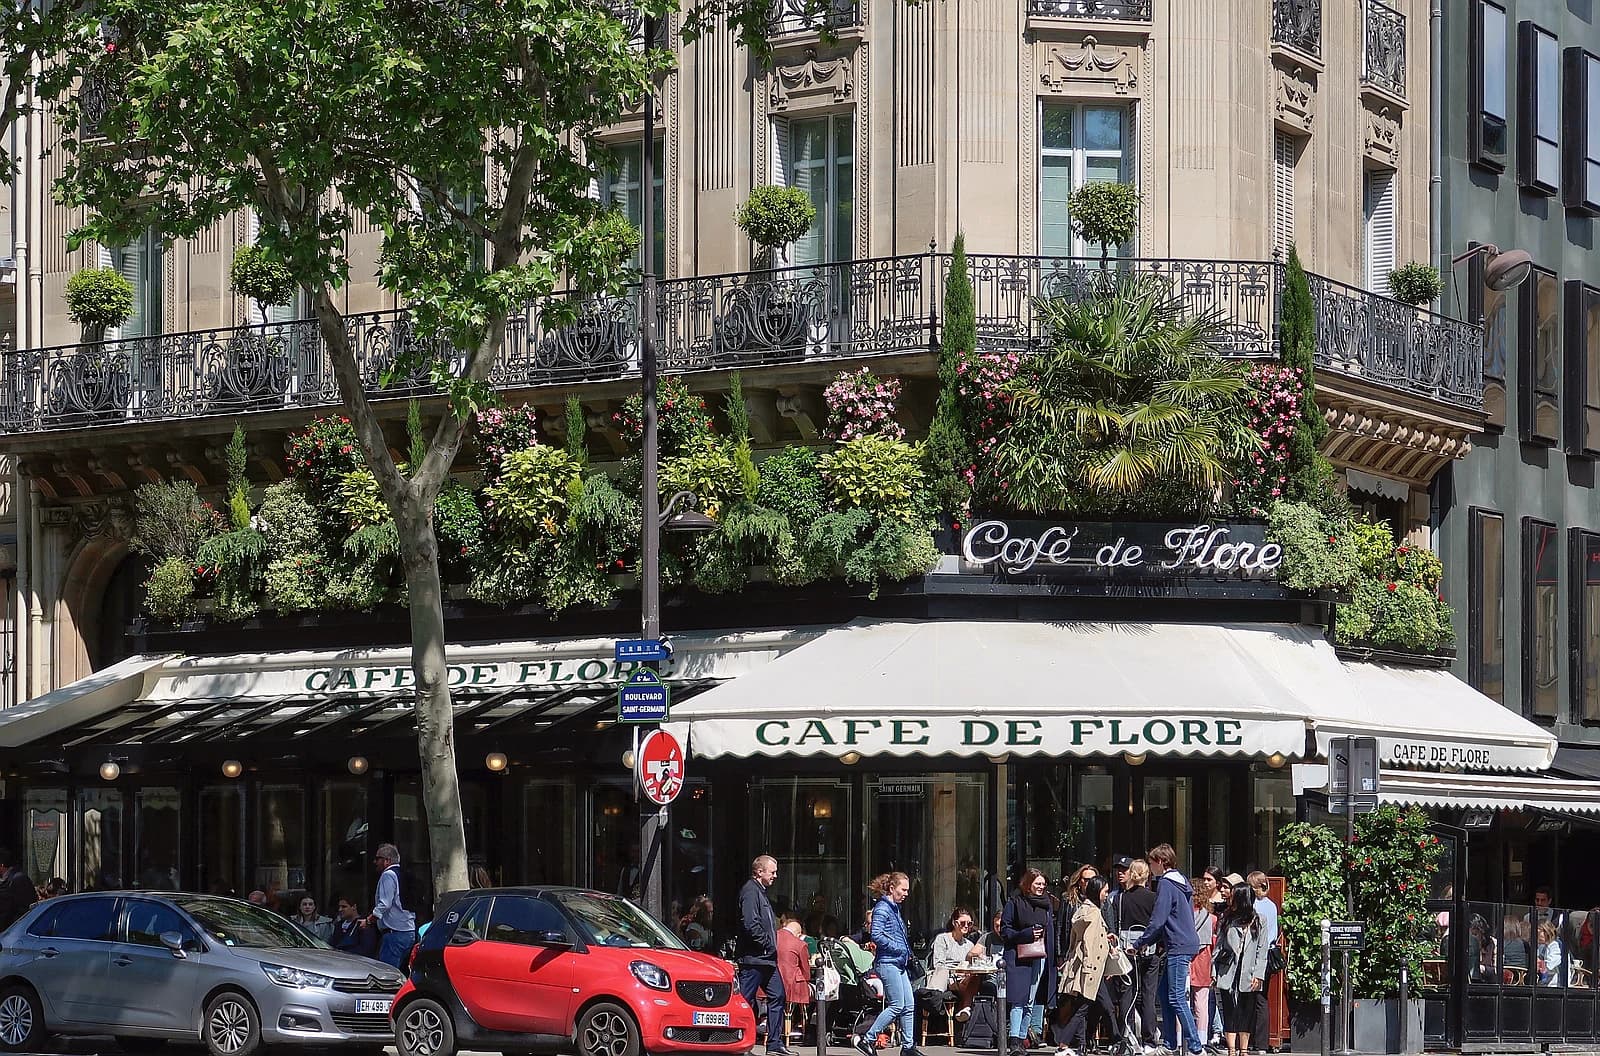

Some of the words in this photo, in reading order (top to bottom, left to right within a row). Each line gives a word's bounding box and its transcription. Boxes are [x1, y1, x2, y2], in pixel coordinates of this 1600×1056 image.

[963, 520, 1078, 574] Café
[1096, 537, 1143, 566] de
[1162, 525, 1282, 569] Flore
[305, 668, 416, 690] CAFE
[625, 693, 663, 701] BOULEVARD
[622, 705, 666, 713] SAINT-GERMAIN
[756, 720, 929, 746] CAFE
[960, 720, 1042, 746] DE
[1070, 720, 1242, 746] FLORE
[1394, 744, 1426, 760] CAFE
[1431, 747, 1447, 762] DE
[1452, 749, 1490, 764] FLORE
